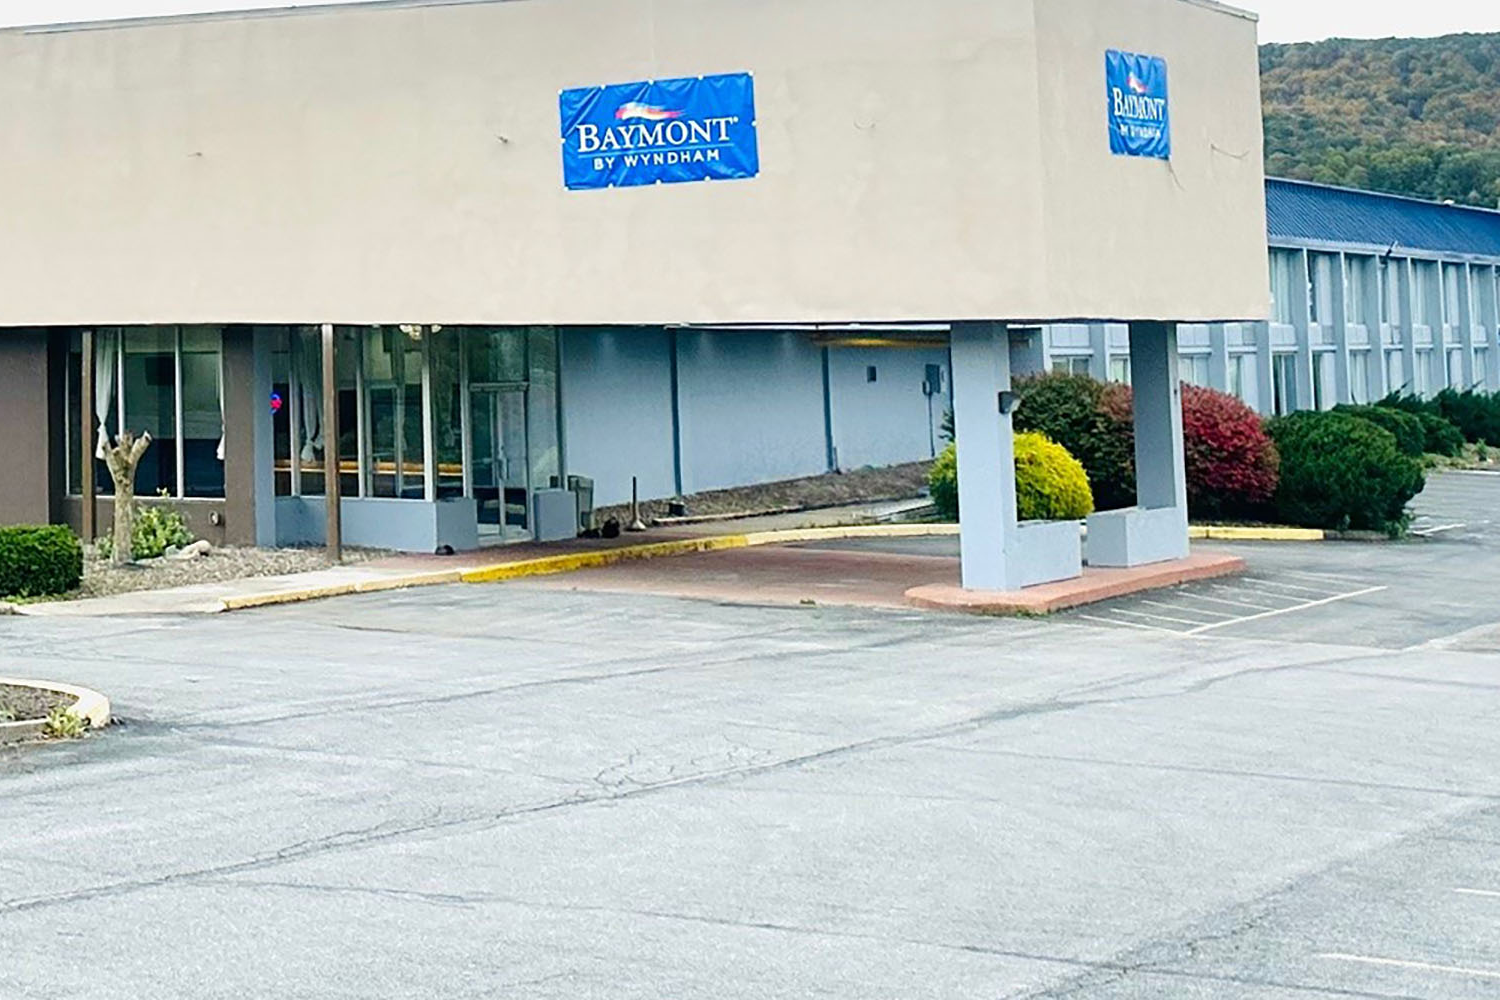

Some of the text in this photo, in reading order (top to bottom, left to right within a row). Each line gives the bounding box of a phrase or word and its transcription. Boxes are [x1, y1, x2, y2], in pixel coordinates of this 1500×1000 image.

[576, 116, 734, 153] BAYMONT
[593, 149, 720, 170] BY WYNDHAM
